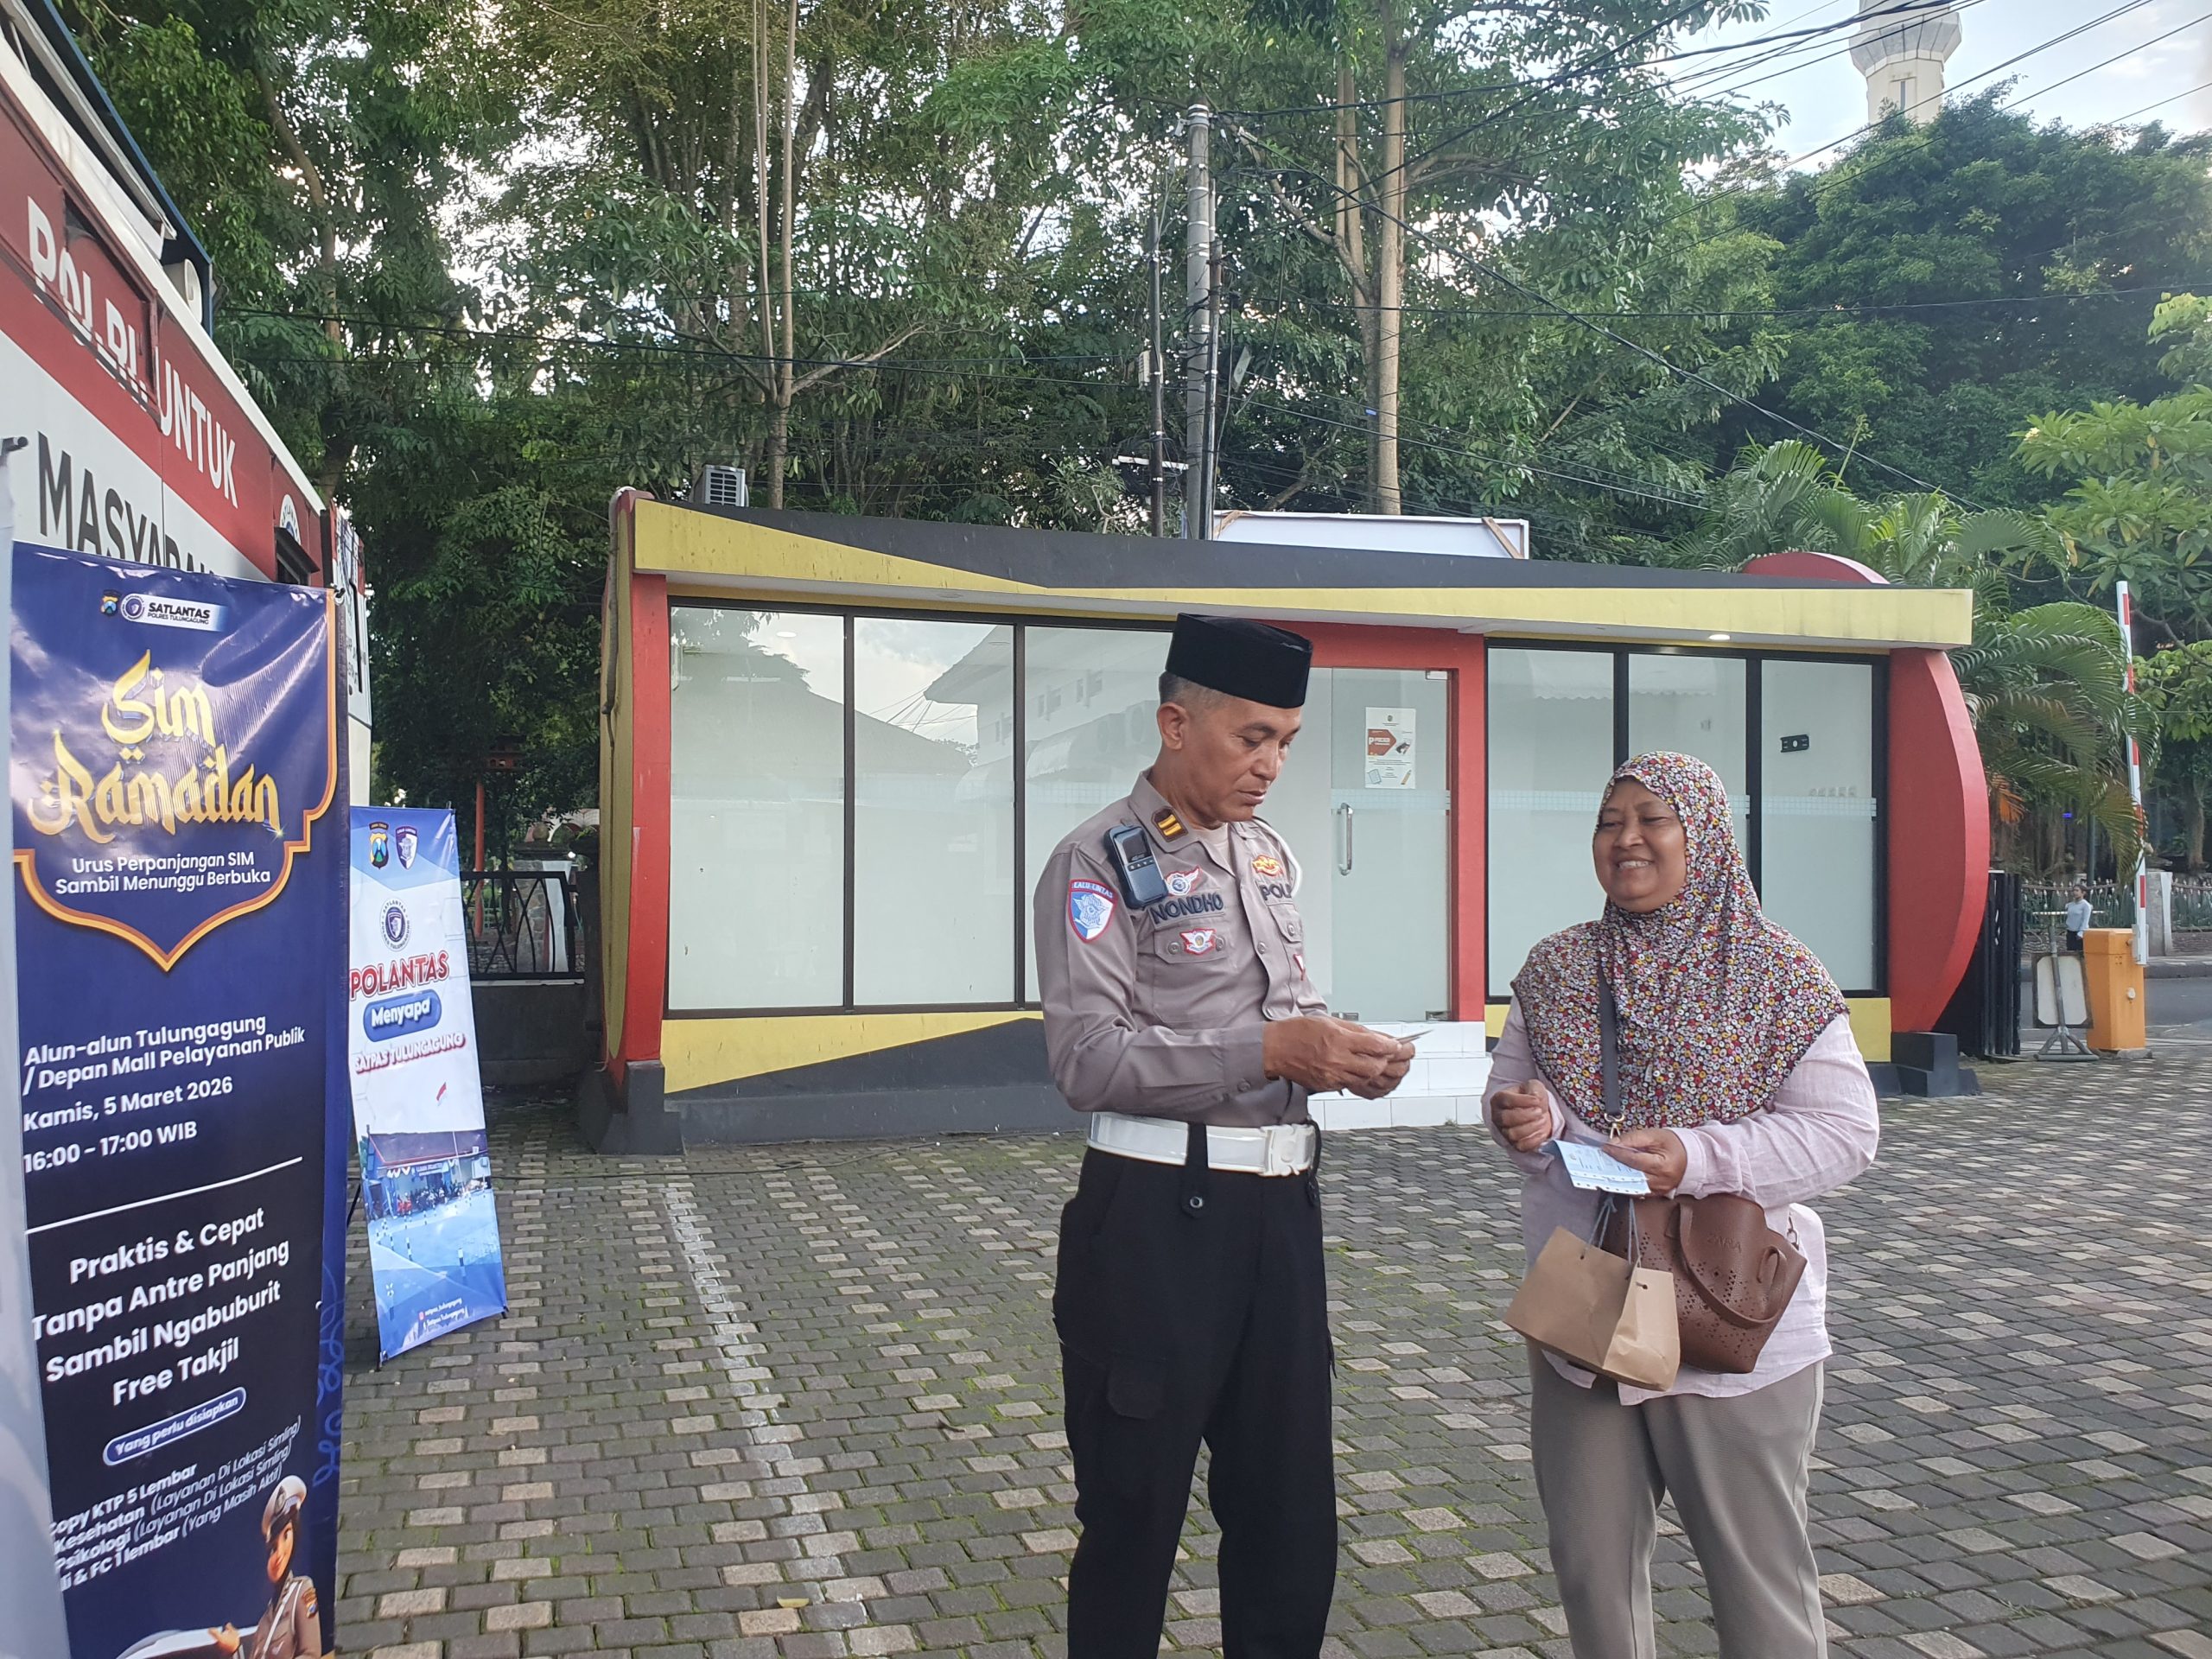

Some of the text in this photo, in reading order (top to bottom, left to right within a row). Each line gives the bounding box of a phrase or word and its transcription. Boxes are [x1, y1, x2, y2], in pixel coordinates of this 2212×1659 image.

[155, 346, 238, 509] UNTUK
[147, 612, 210, 625] POLRES TULUNGAGUNG
[148, 602, 211, 620] SATLANTAS
[101, 649, 216, 748] Sim
[27, 730, 282, 843] Ramadan
[55, 868, 270, 894] Sambil Menunggu Berbuka
[72, 851, 255, 875] Urus Perpanjangan SIM
[1149, 892, 1224, 925] NONDHO
[350, 951, 448, 1001] POLANTAS
[23, 1015, 266, 1066] Alun-alun Tulungagung
[371, 995, 432, 1028] Menyapa
[22, 1027, 305, 1096] / Depan Mall Pelayanan Publik
[389, 1033, 467, 1065] TULUNGAGUNG
[23, 1076, 233, 1132] Kamis, 5 Maret 2026
[23, 1143, 80, 1173] 16:00
[99, 1128, 153, 1157] 17:00
[156, 1121, 198, 1145] WIB
[70, 1207, 264, 1284] Praktis & Cepat
[31, 1240, 289, 1341] Tanpa Antre Panjang
[46, 1280, 281, 1382] Sambil Ngabuburit
[113, 1337, 239, 1406] Free Takjil
[115, 1396, 238, 1456] Yang perlu disiapkan
[54, 1414, 302, 1555] Kesehatan (Layanan Di Lokasi Simling)
[55, 1437, 292, 1573] Psikologi (Layanan Di Lokasi Simling)
[92, 1494, 124, 1519] KTP
[127, 1487, 137, 1504] 5
[139, 1464, 198, 1500] Lembar
[73, 1567, 88, 1586] &
[89, 1556, 113, 1580] FC
[114, 1551, 122, 1567] 1
[124, 1526, 181, 1563] lembar
[181, 1505, 222, 1537] (Yang
[224, 1484, 257, 1513] Masih
[257, 1461, 282, 1492] Aktif)
